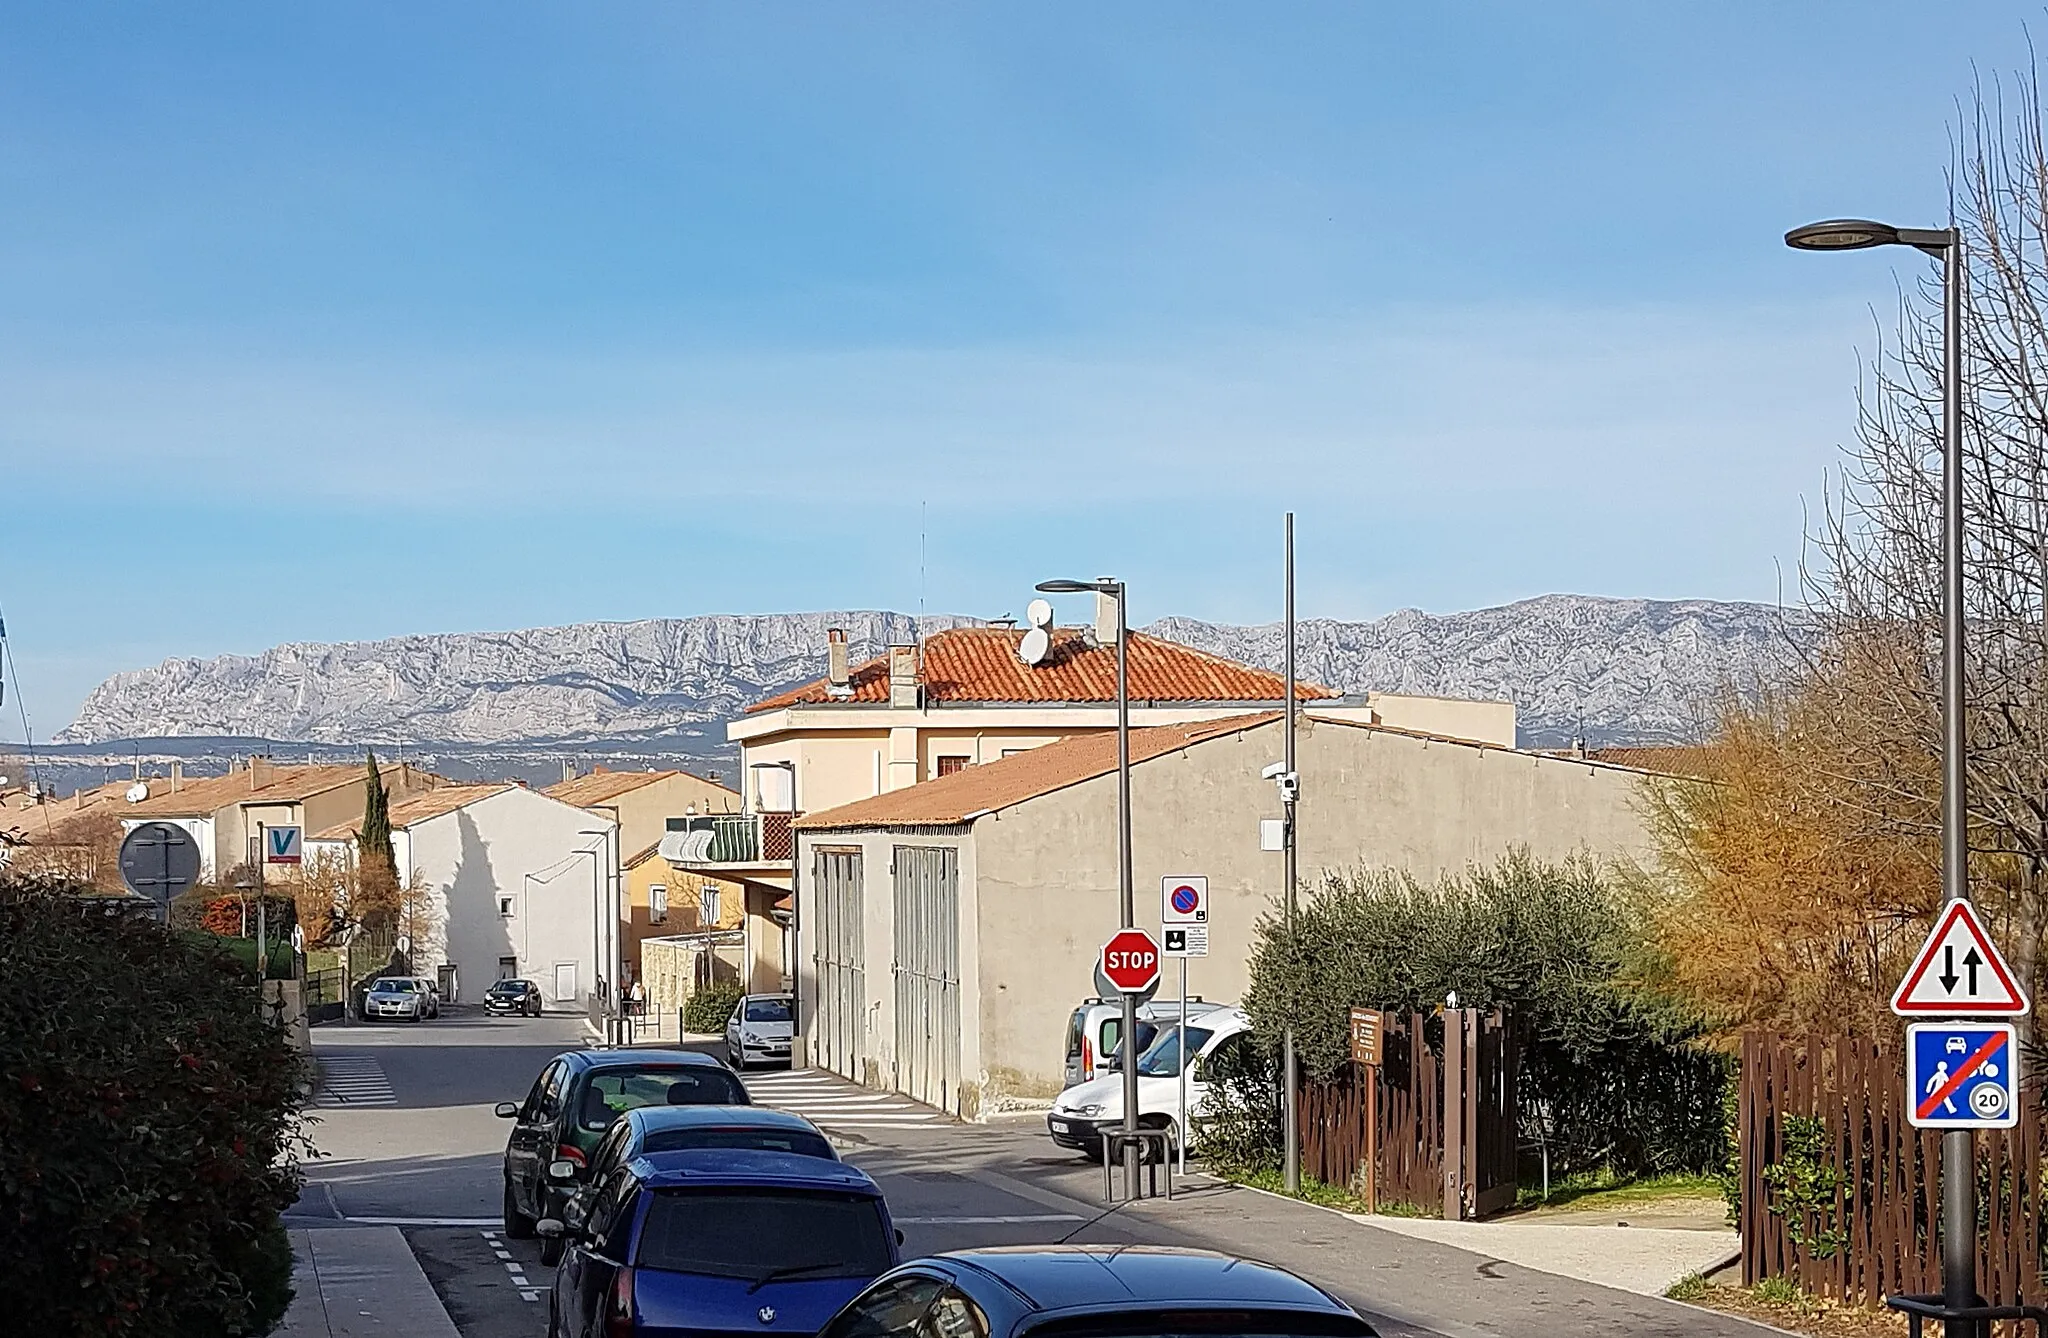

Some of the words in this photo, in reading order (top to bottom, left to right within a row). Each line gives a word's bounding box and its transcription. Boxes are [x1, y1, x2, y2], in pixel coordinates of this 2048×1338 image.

[272, 830, 296, 855] V
[1108, 951, 1155, 969] STOP
[1979, 1094, 1999, 1107] 20
